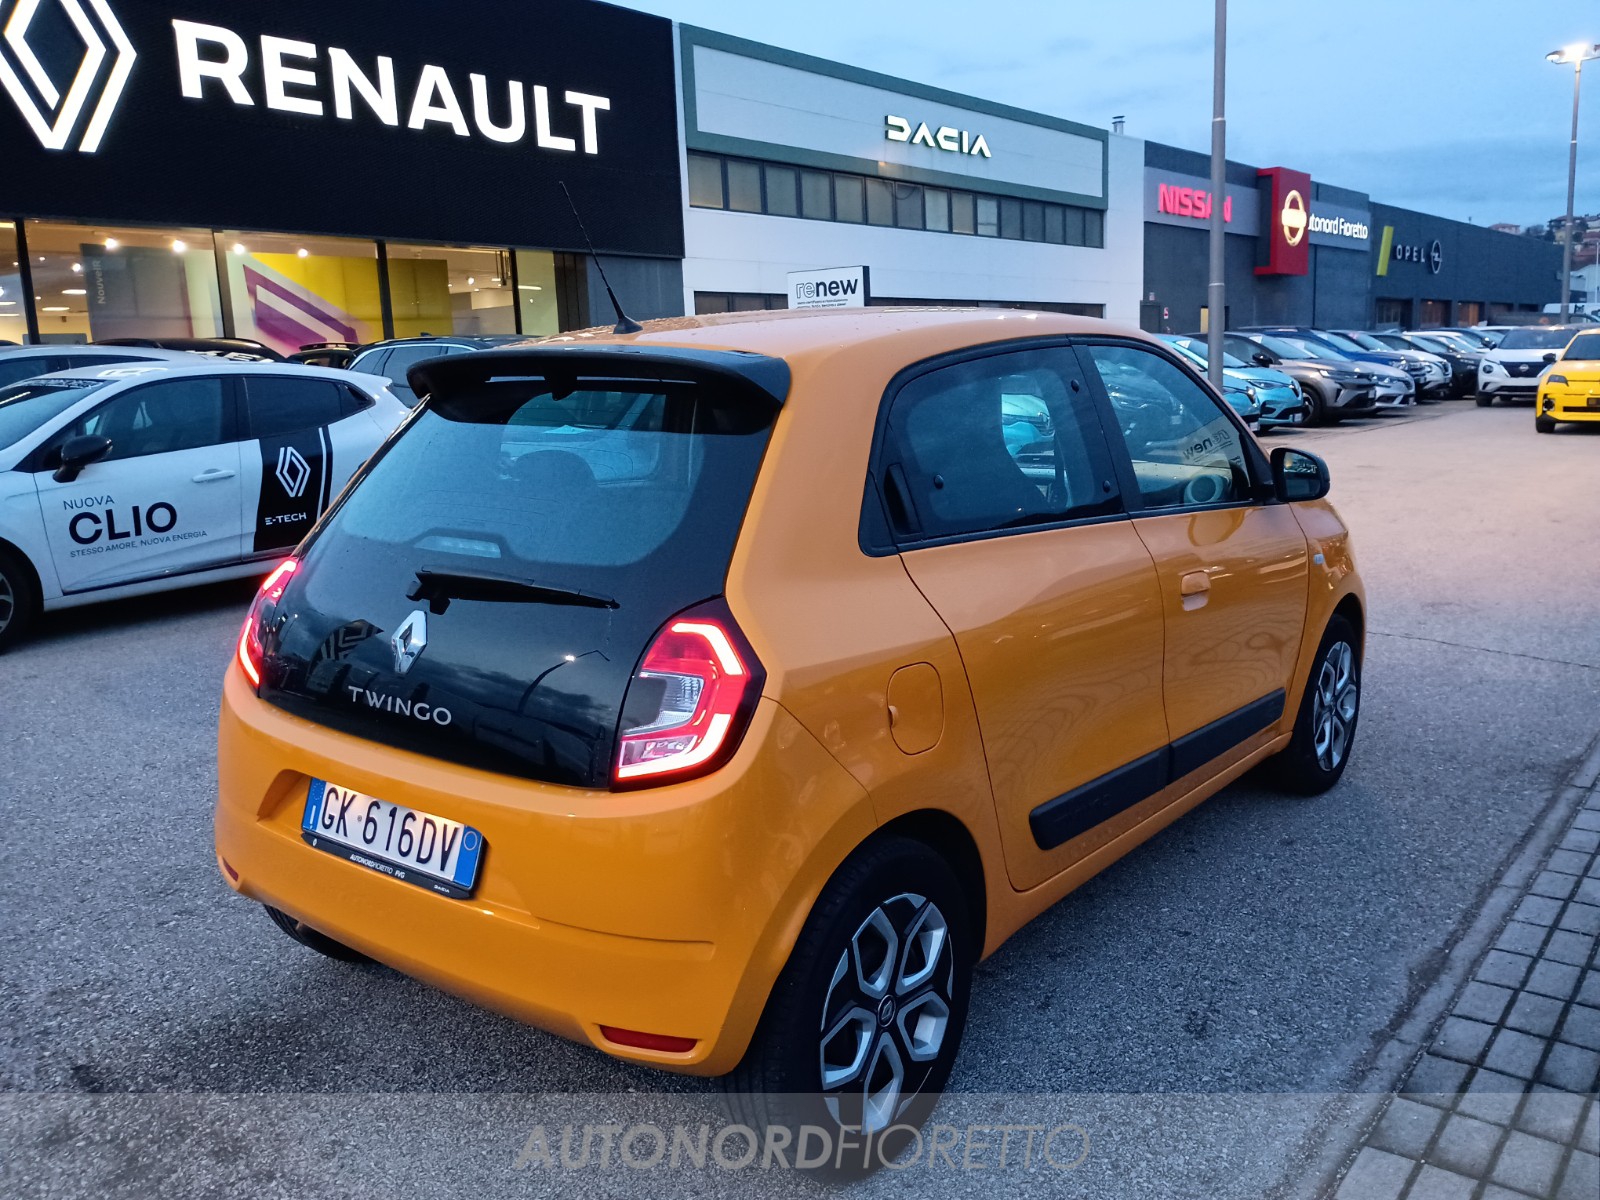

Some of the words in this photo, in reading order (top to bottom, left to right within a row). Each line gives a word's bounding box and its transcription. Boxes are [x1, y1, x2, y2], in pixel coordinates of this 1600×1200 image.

[172, 19, 610, 155] RENAULT
[885, 115, 992, 158] DACIA
[1339, 217, 1368, 240] Fioretto
[1396, 244, 1425, 263] OPEL
[796, 279, 858, 299] renew
[63, 495, 115, 510] NUOVA
[69, 502, 177, 545] CLIO
[264, 512, 307, 525] E-TECH
[70, 547, 104, 558] STESSO
[140, 535, 171, 547] NUOVA
[172, 530, 207, 542] ENERGIA
[348, 685, 452, 726] TWINGO
